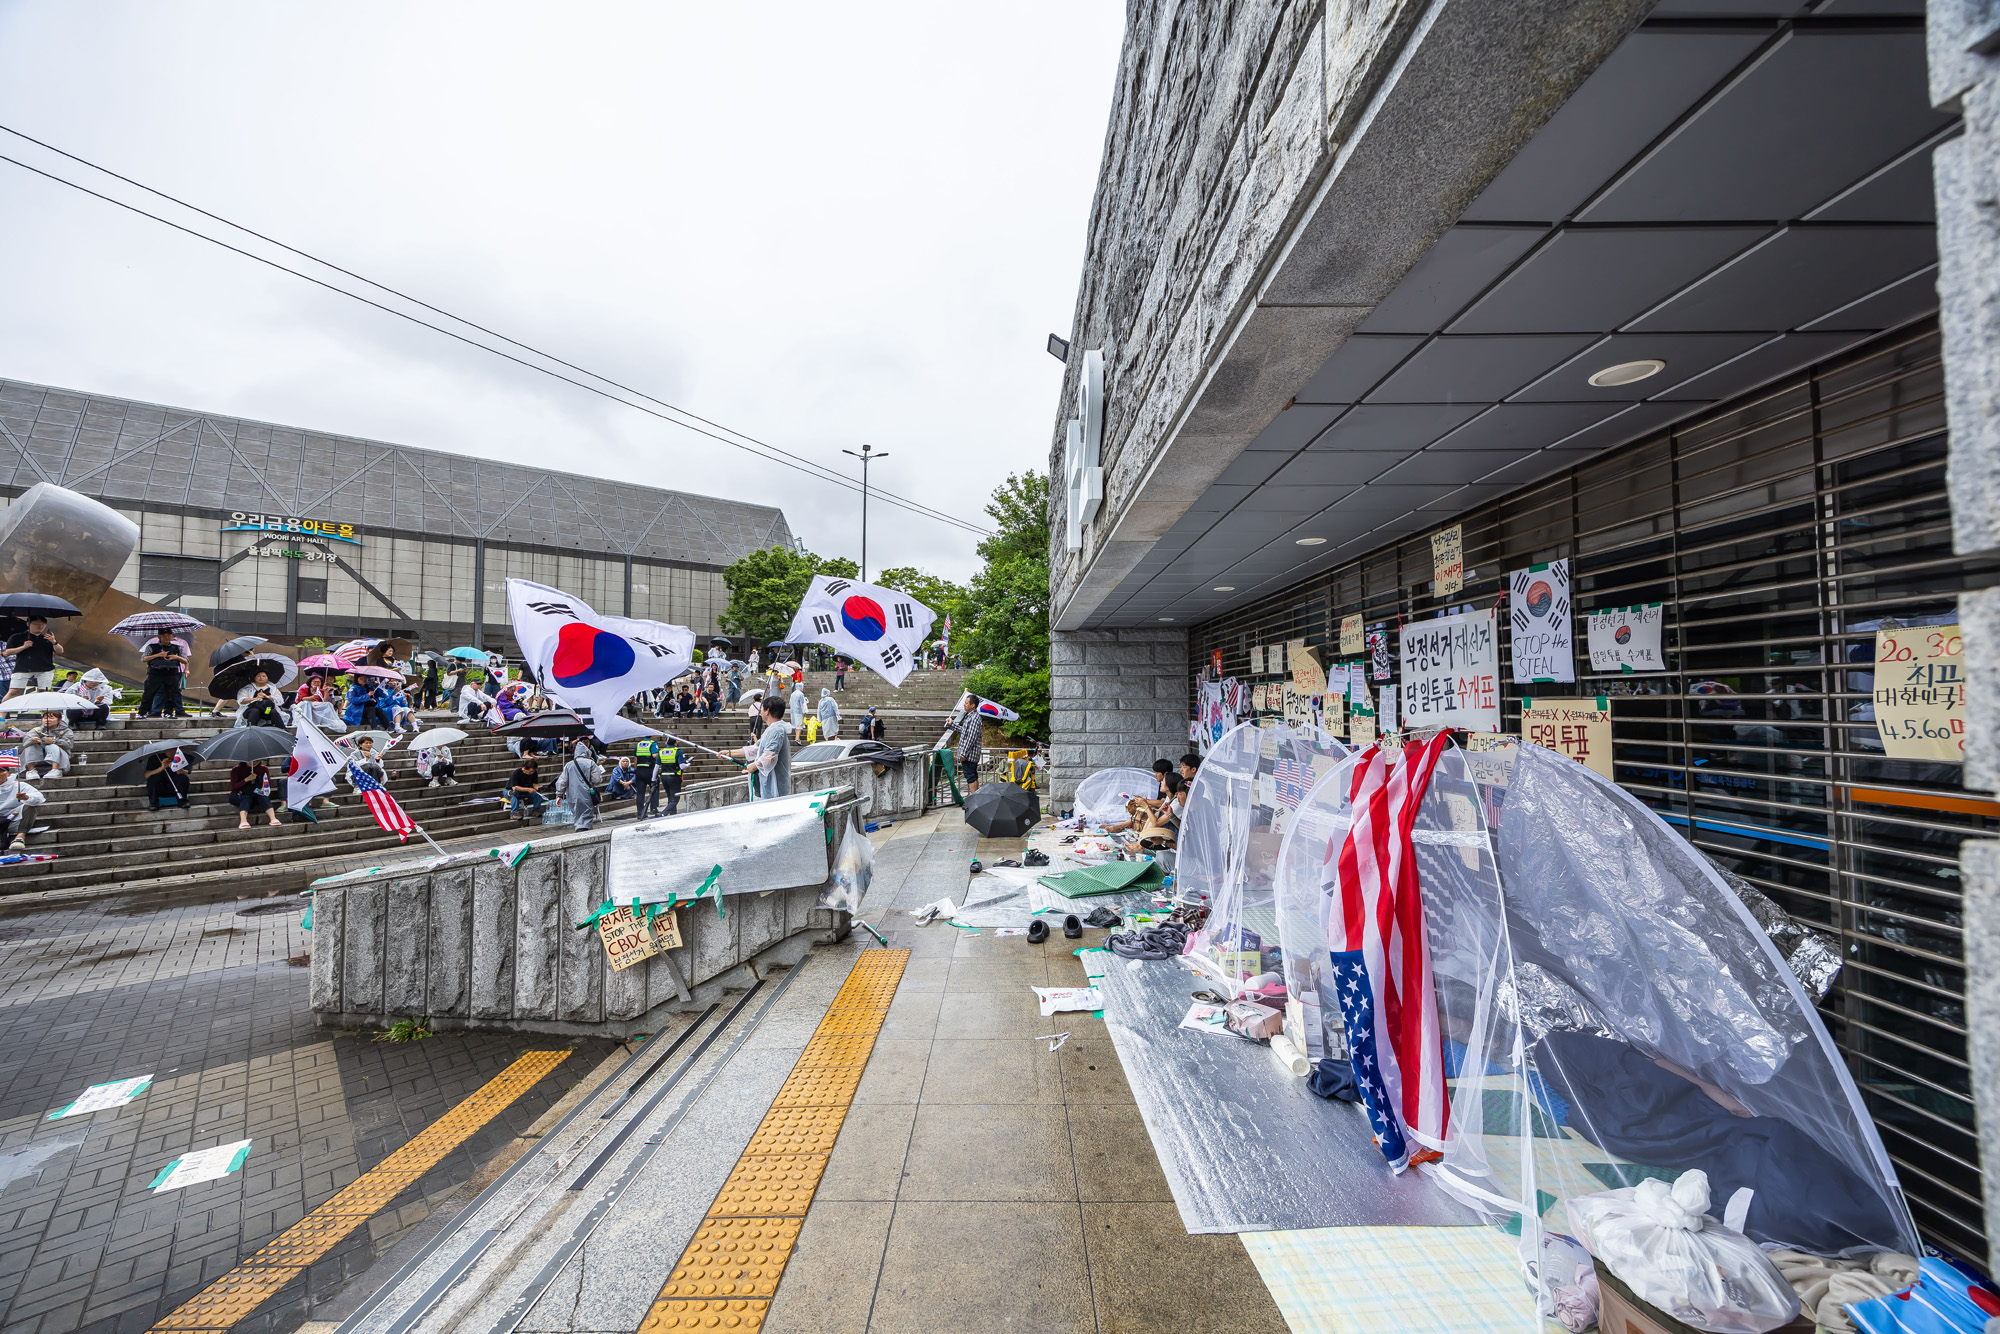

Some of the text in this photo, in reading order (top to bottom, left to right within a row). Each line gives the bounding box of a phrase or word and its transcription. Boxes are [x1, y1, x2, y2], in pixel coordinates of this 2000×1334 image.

[229, 512, 354, 538] 우리금융아트홀
[264, 532, 289, 541] WOORI
[1436, 562, 1463, 582] 이재명
[1445, 581, 1458, 592] 이다
[1593, 609, 1659, 631] 부정선거 재선거
[1513, 633, 1569, 659] STOP the
[1593, 649, 1655, 665] 당일투표 수개표
[1519, 657, 1559, 677] STEAL
[605, 926, 625, 943] STOP
[629, 920, 647, 932] THE
[608, 930, 649, 956] CBDC
[613, 947, 646, 969] 부정선거
